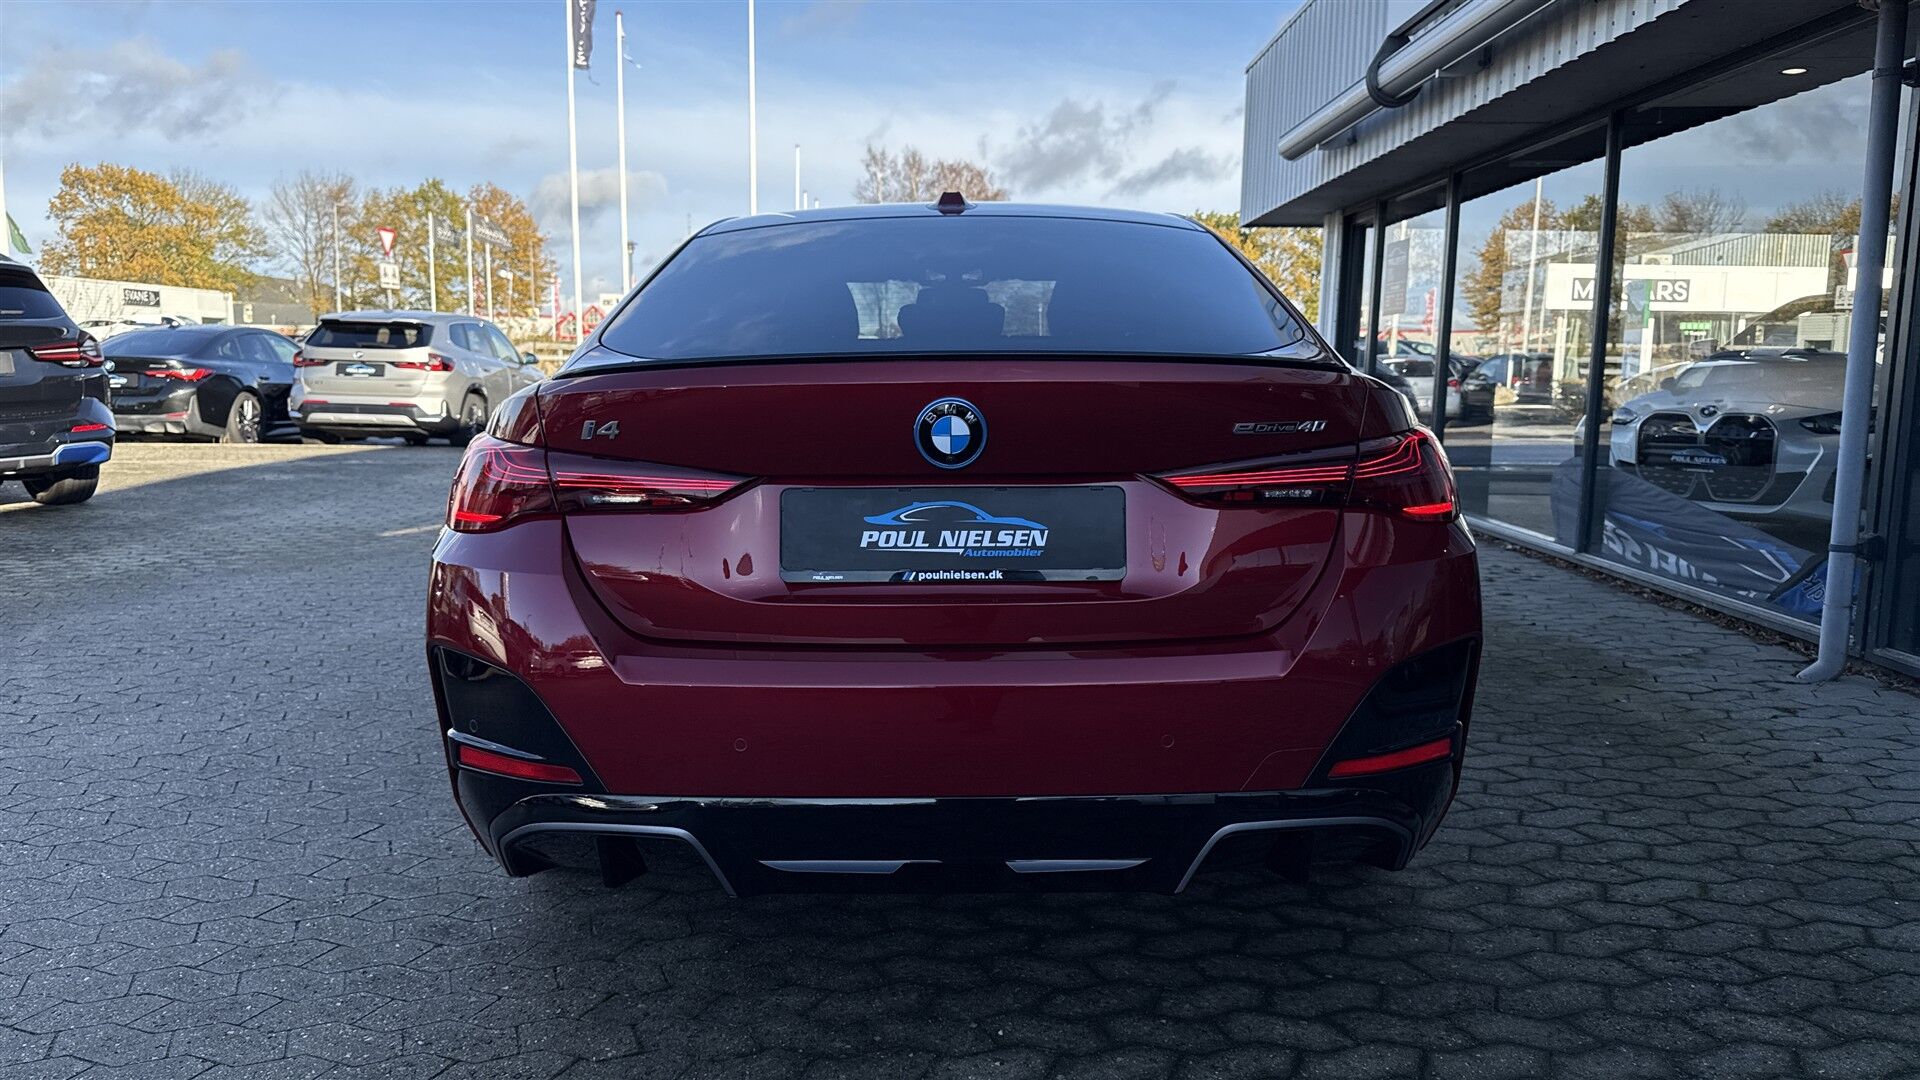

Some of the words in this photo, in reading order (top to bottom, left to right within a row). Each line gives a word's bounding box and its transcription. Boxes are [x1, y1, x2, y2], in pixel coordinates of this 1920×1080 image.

[925, 404, 978, 424] BMW
[581, 420, 619, 440] i4
[860, 530, 929, 548] POUL
[938, 529, 1049, 548] NIELSEN
[963, 549, 1044, 557] Automobiler
[918, 570, 1004, 582] poulnielsen.dk
